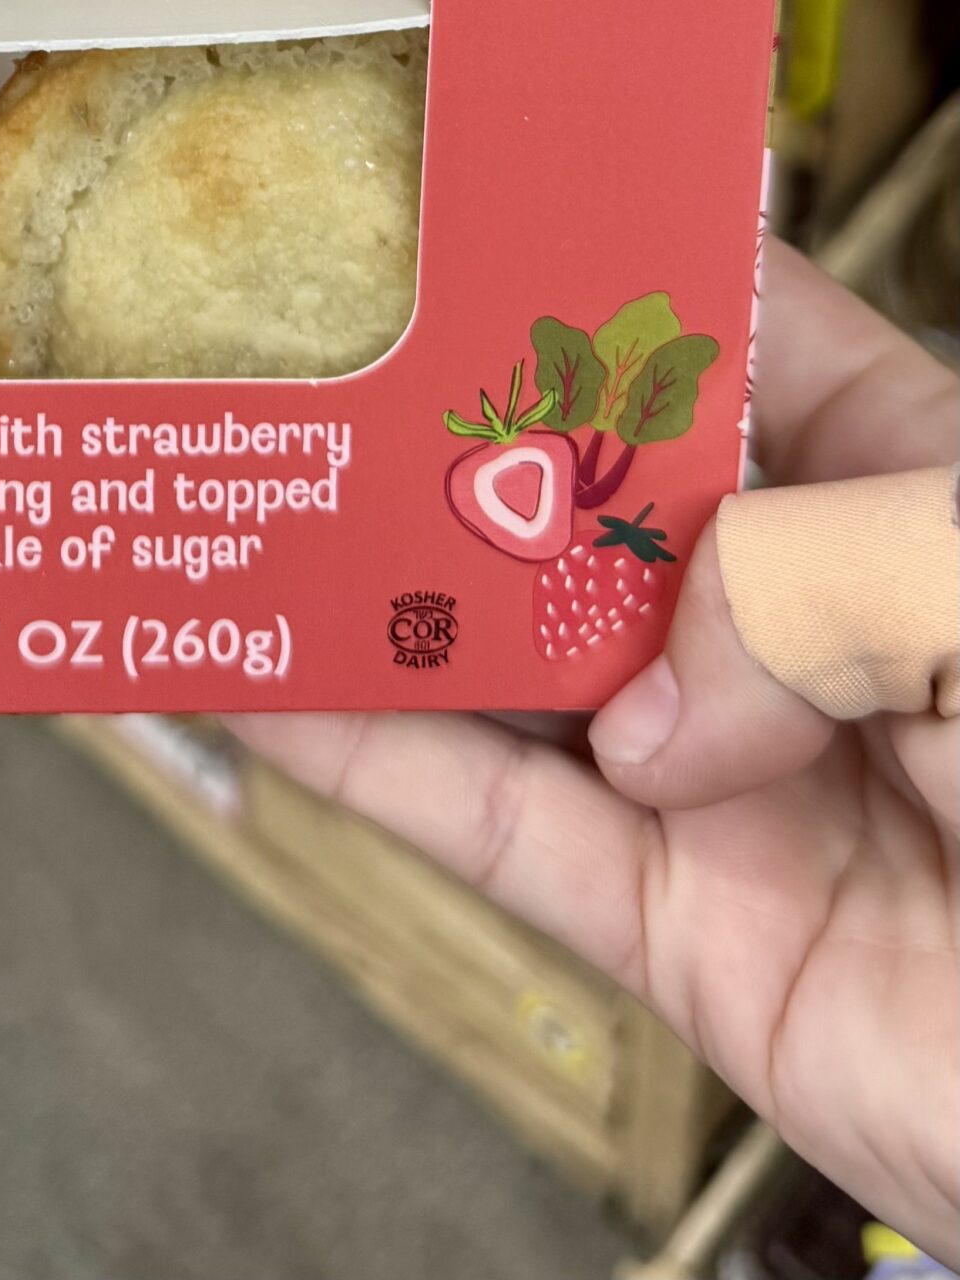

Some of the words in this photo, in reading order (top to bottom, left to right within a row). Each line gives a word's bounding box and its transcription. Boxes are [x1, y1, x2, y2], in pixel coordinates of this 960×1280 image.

[81, 412, 352, 467] strawberry
[71, 468, 155, 514] and
[174, 467, 339, 522] topped
[60, 526, 116, 570] of
[132, 535, 262, 581] sugar
[390, 591, 456, 611] KOSHER
[18, 620, 103, 666] OZ
[122, 614, 291, 678] (260g)
[390, 618, 456, 641] COR
[393, 649, 449, 669] DAIRY
